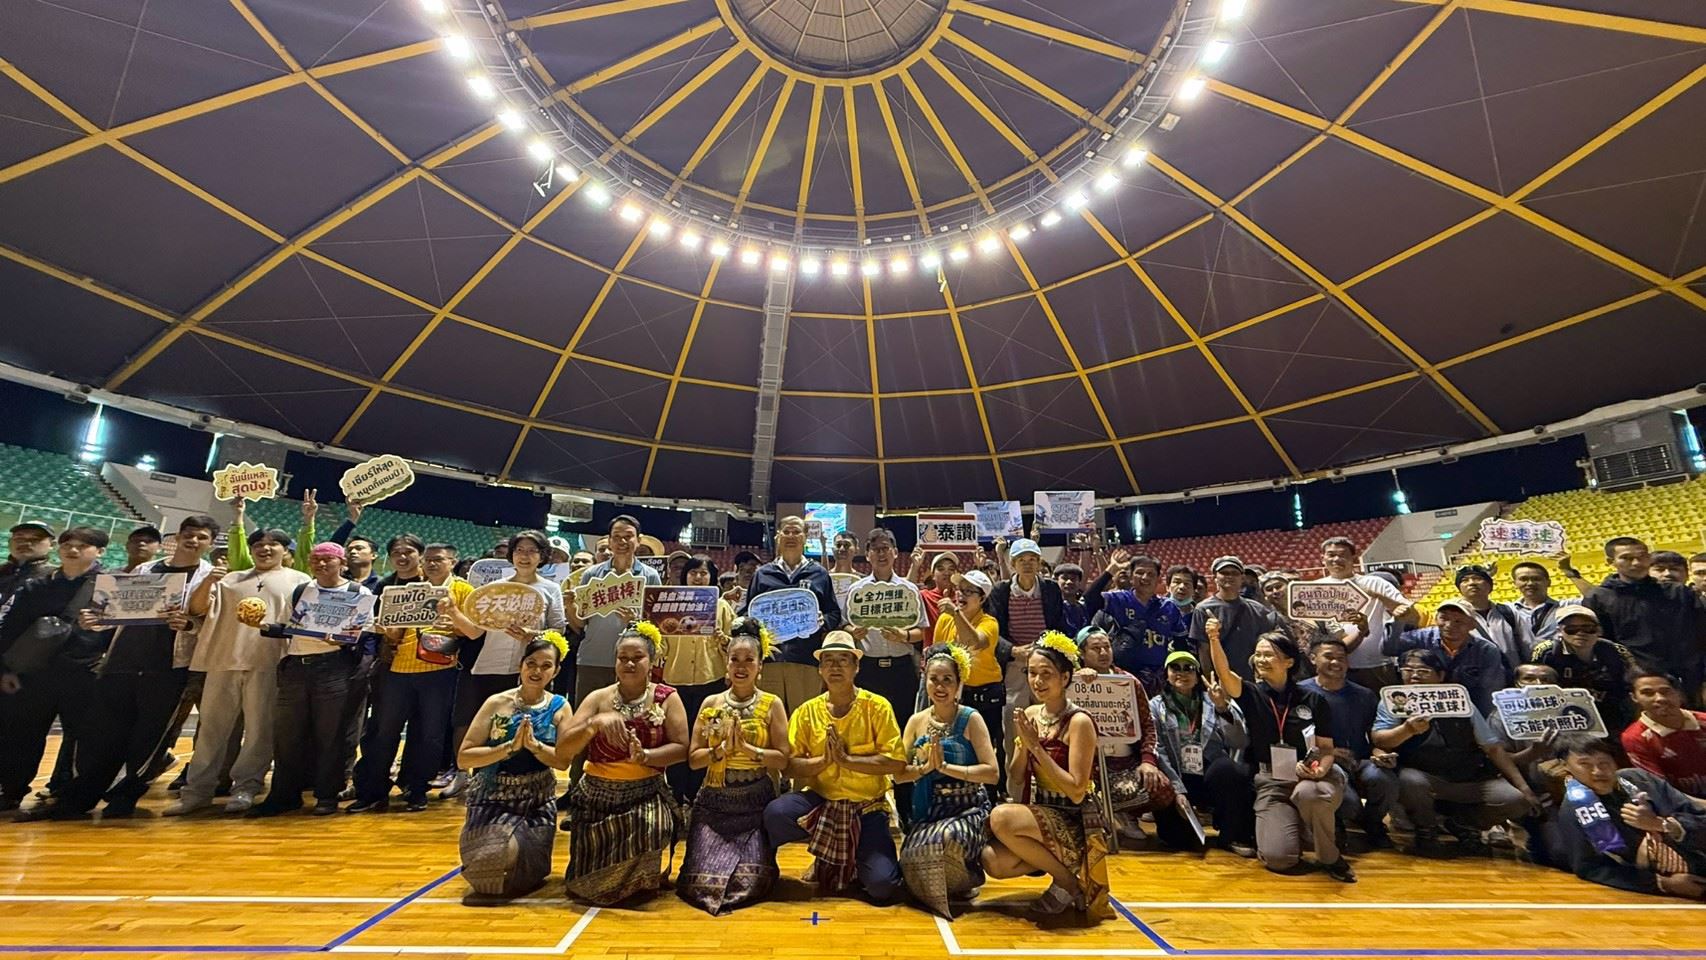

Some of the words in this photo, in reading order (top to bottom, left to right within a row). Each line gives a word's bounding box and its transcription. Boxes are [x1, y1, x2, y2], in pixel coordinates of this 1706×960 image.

[592, 580, 641, 608] 我最棒!
[475, 592, 537, 615] 今天必勝
[1074, 683, 1102, 694] 08:40
[1419, 700, 1466, 714] 只進球!
